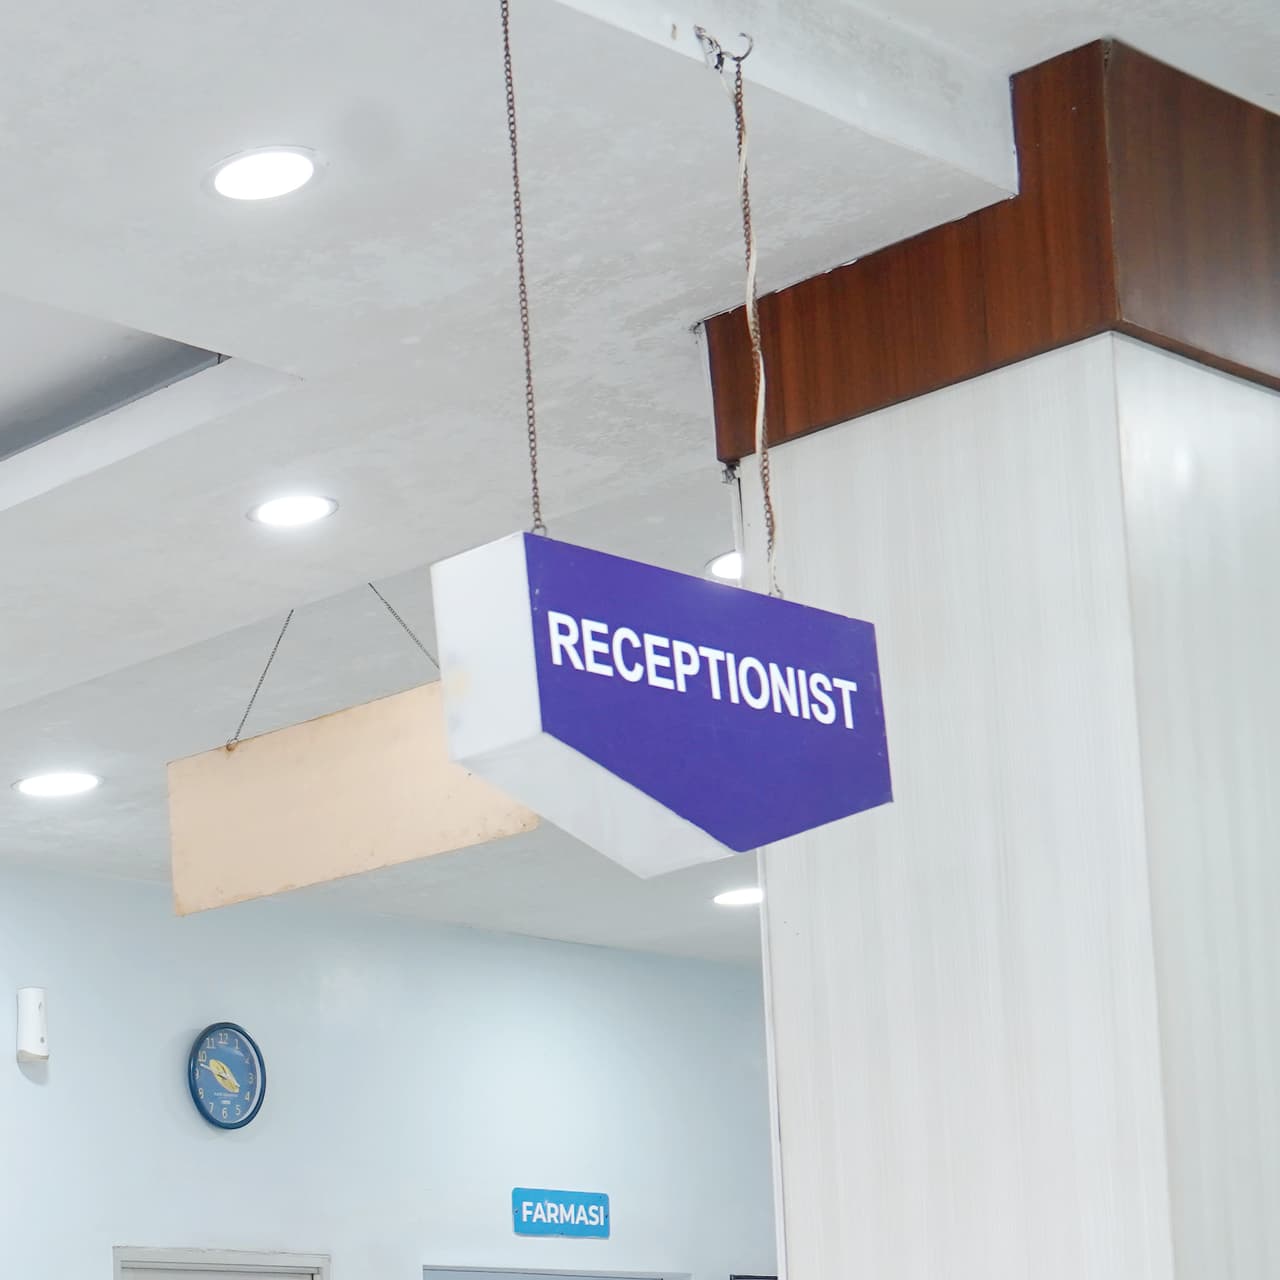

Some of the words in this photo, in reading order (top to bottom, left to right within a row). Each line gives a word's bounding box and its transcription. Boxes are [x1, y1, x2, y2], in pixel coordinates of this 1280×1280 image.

[547, 610, 857, 730] RECEPTIONIST
[206, 1038, 216, 1049] 11
[235, 1039, 241, 1050] 1
[248, 1072, 255, 1085] 3
[244, 1091, 250, 1102] 4
[209, 1102, 214, 1113] 7
[222, 1107, 228, 1119] 6
[235, 1104, 241, 1116] 5
[521, 1200, 605, 1226] FARMASI
